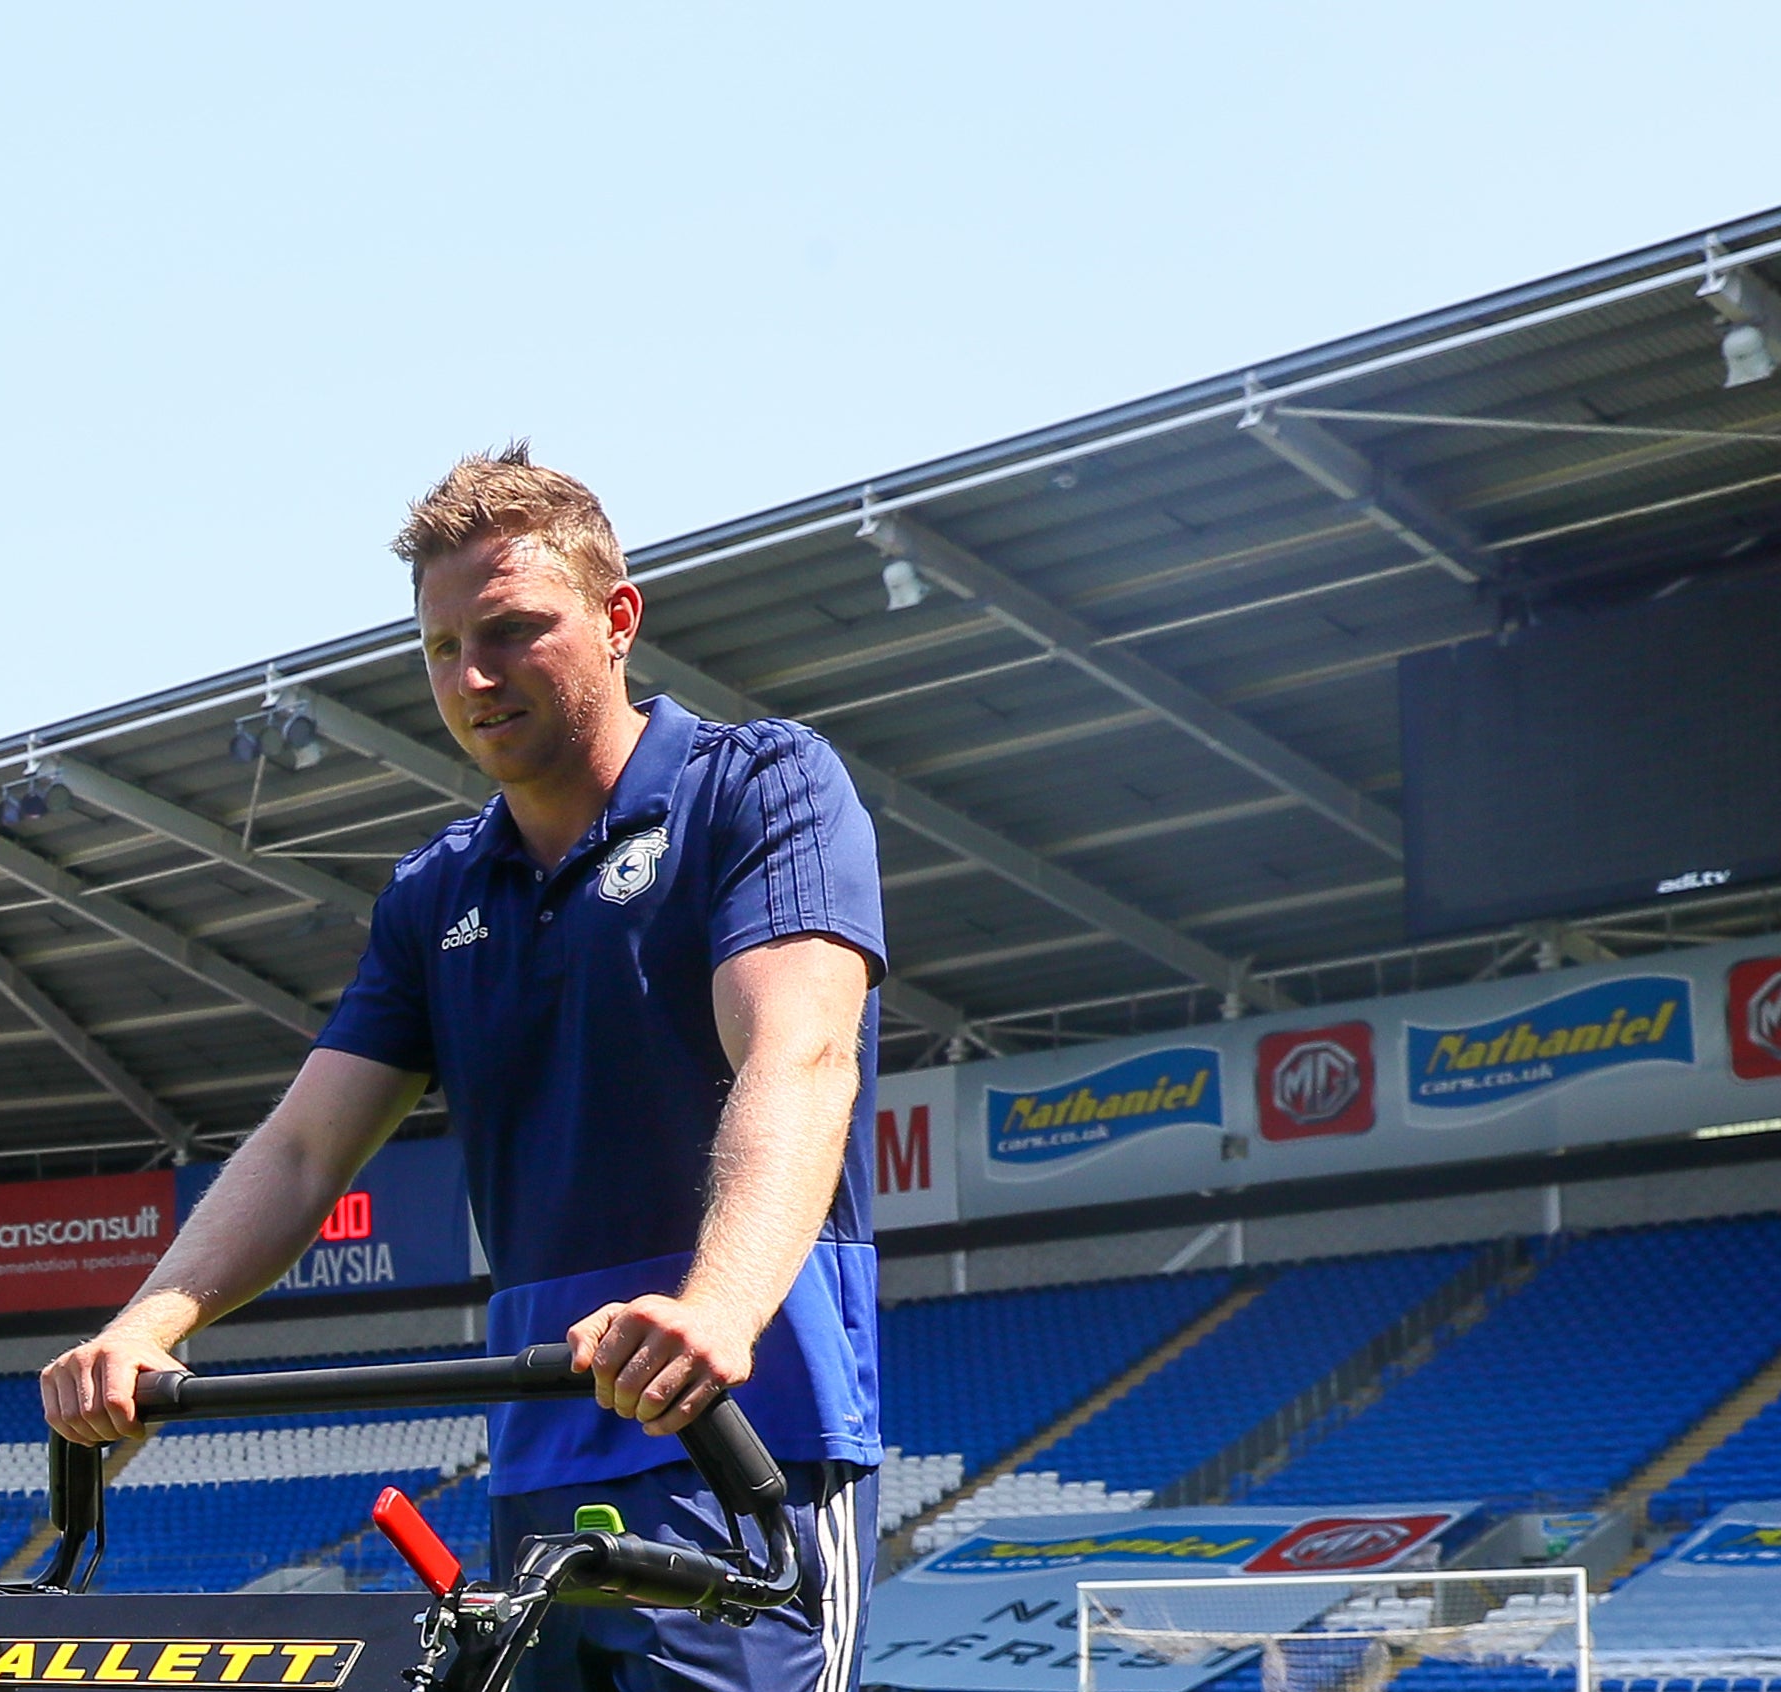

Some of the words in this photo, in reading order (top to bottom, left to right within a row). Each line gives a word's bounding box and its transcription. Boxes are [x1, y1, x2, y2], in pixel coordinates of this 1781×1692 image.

[441, 927, 489, 950] adidas
[1426, 1001, 1677, 1074] Nathaniel
[1002, 1069, 1211, 1134] Nathaniel
[1280, 1049, 1360, 1113] MG
